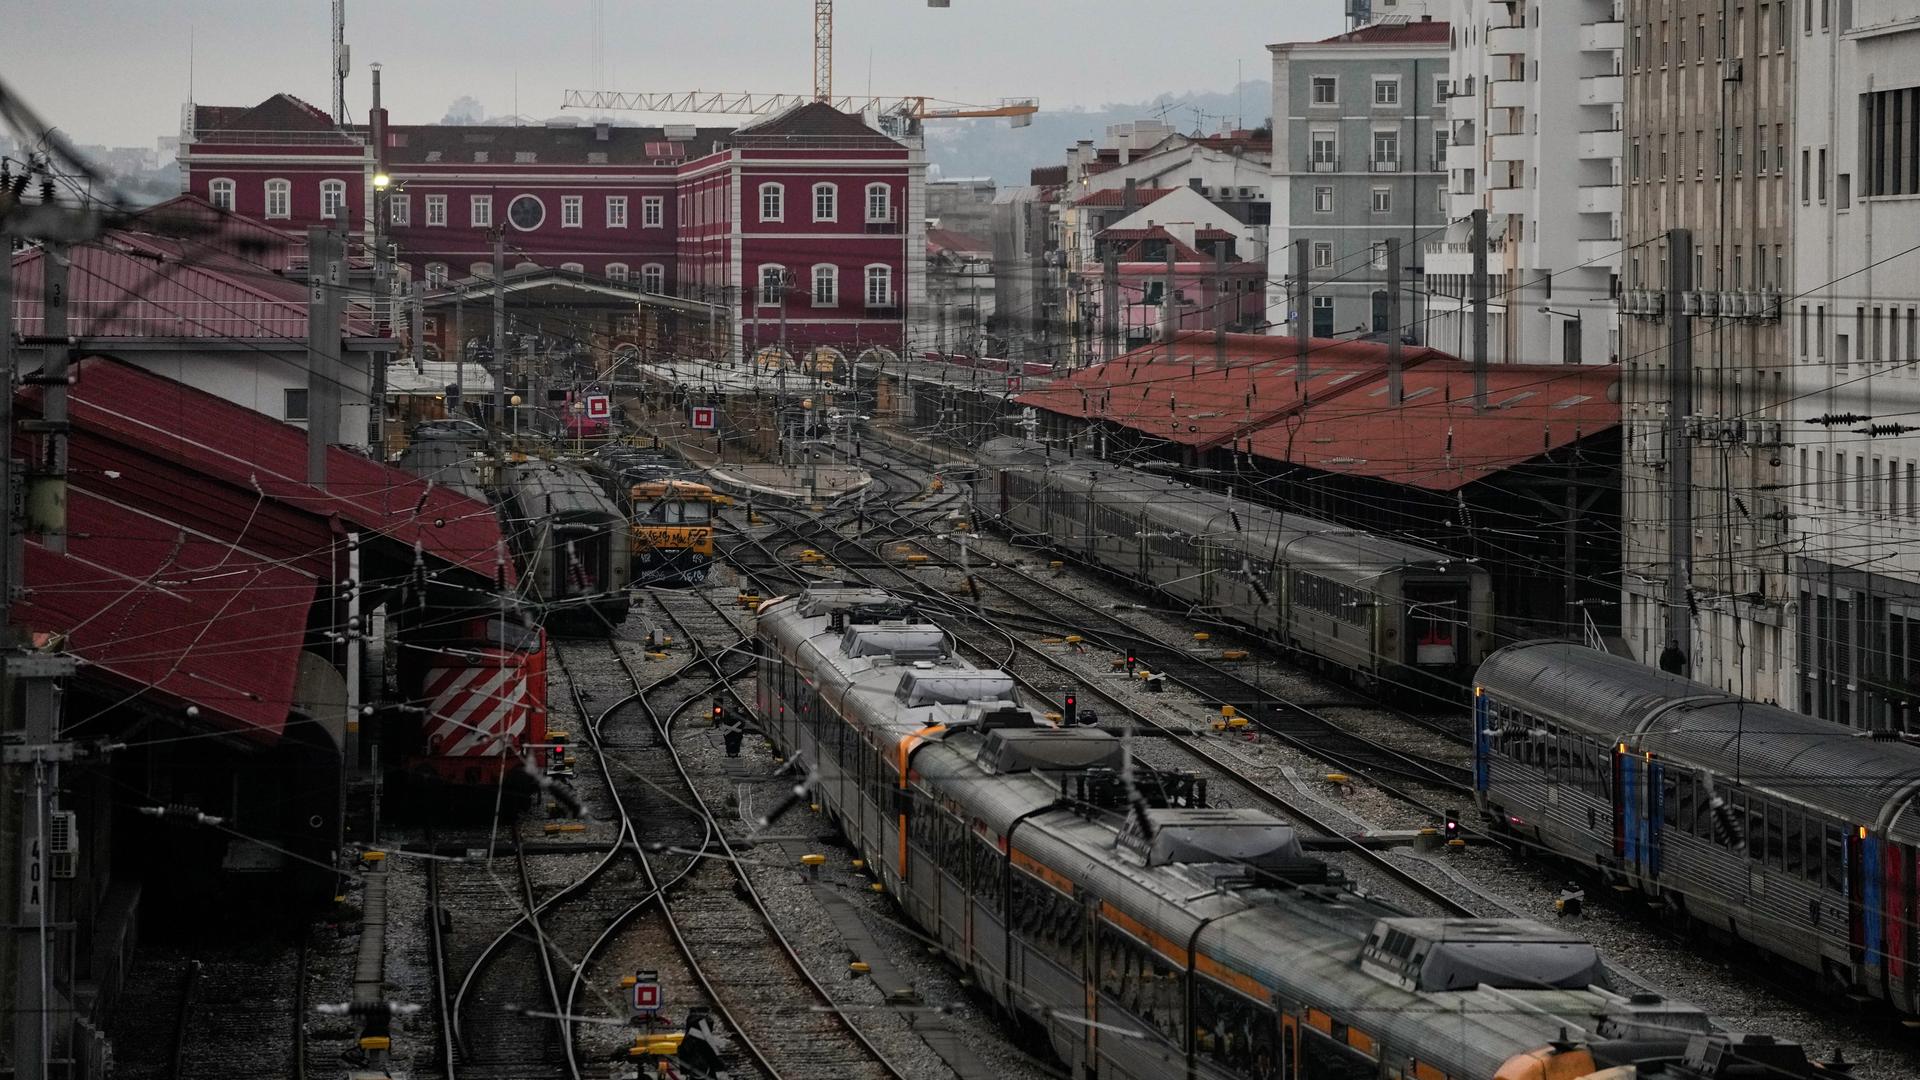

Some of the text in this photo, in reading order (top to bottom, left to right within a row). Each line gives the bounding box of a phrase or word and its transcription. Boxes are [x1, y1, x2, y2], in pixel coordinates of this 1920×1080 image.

[315, 278, 321, 300] 36
[1206, 715, 1212, 724] 6
[30, 840, 40, 905] 40A
